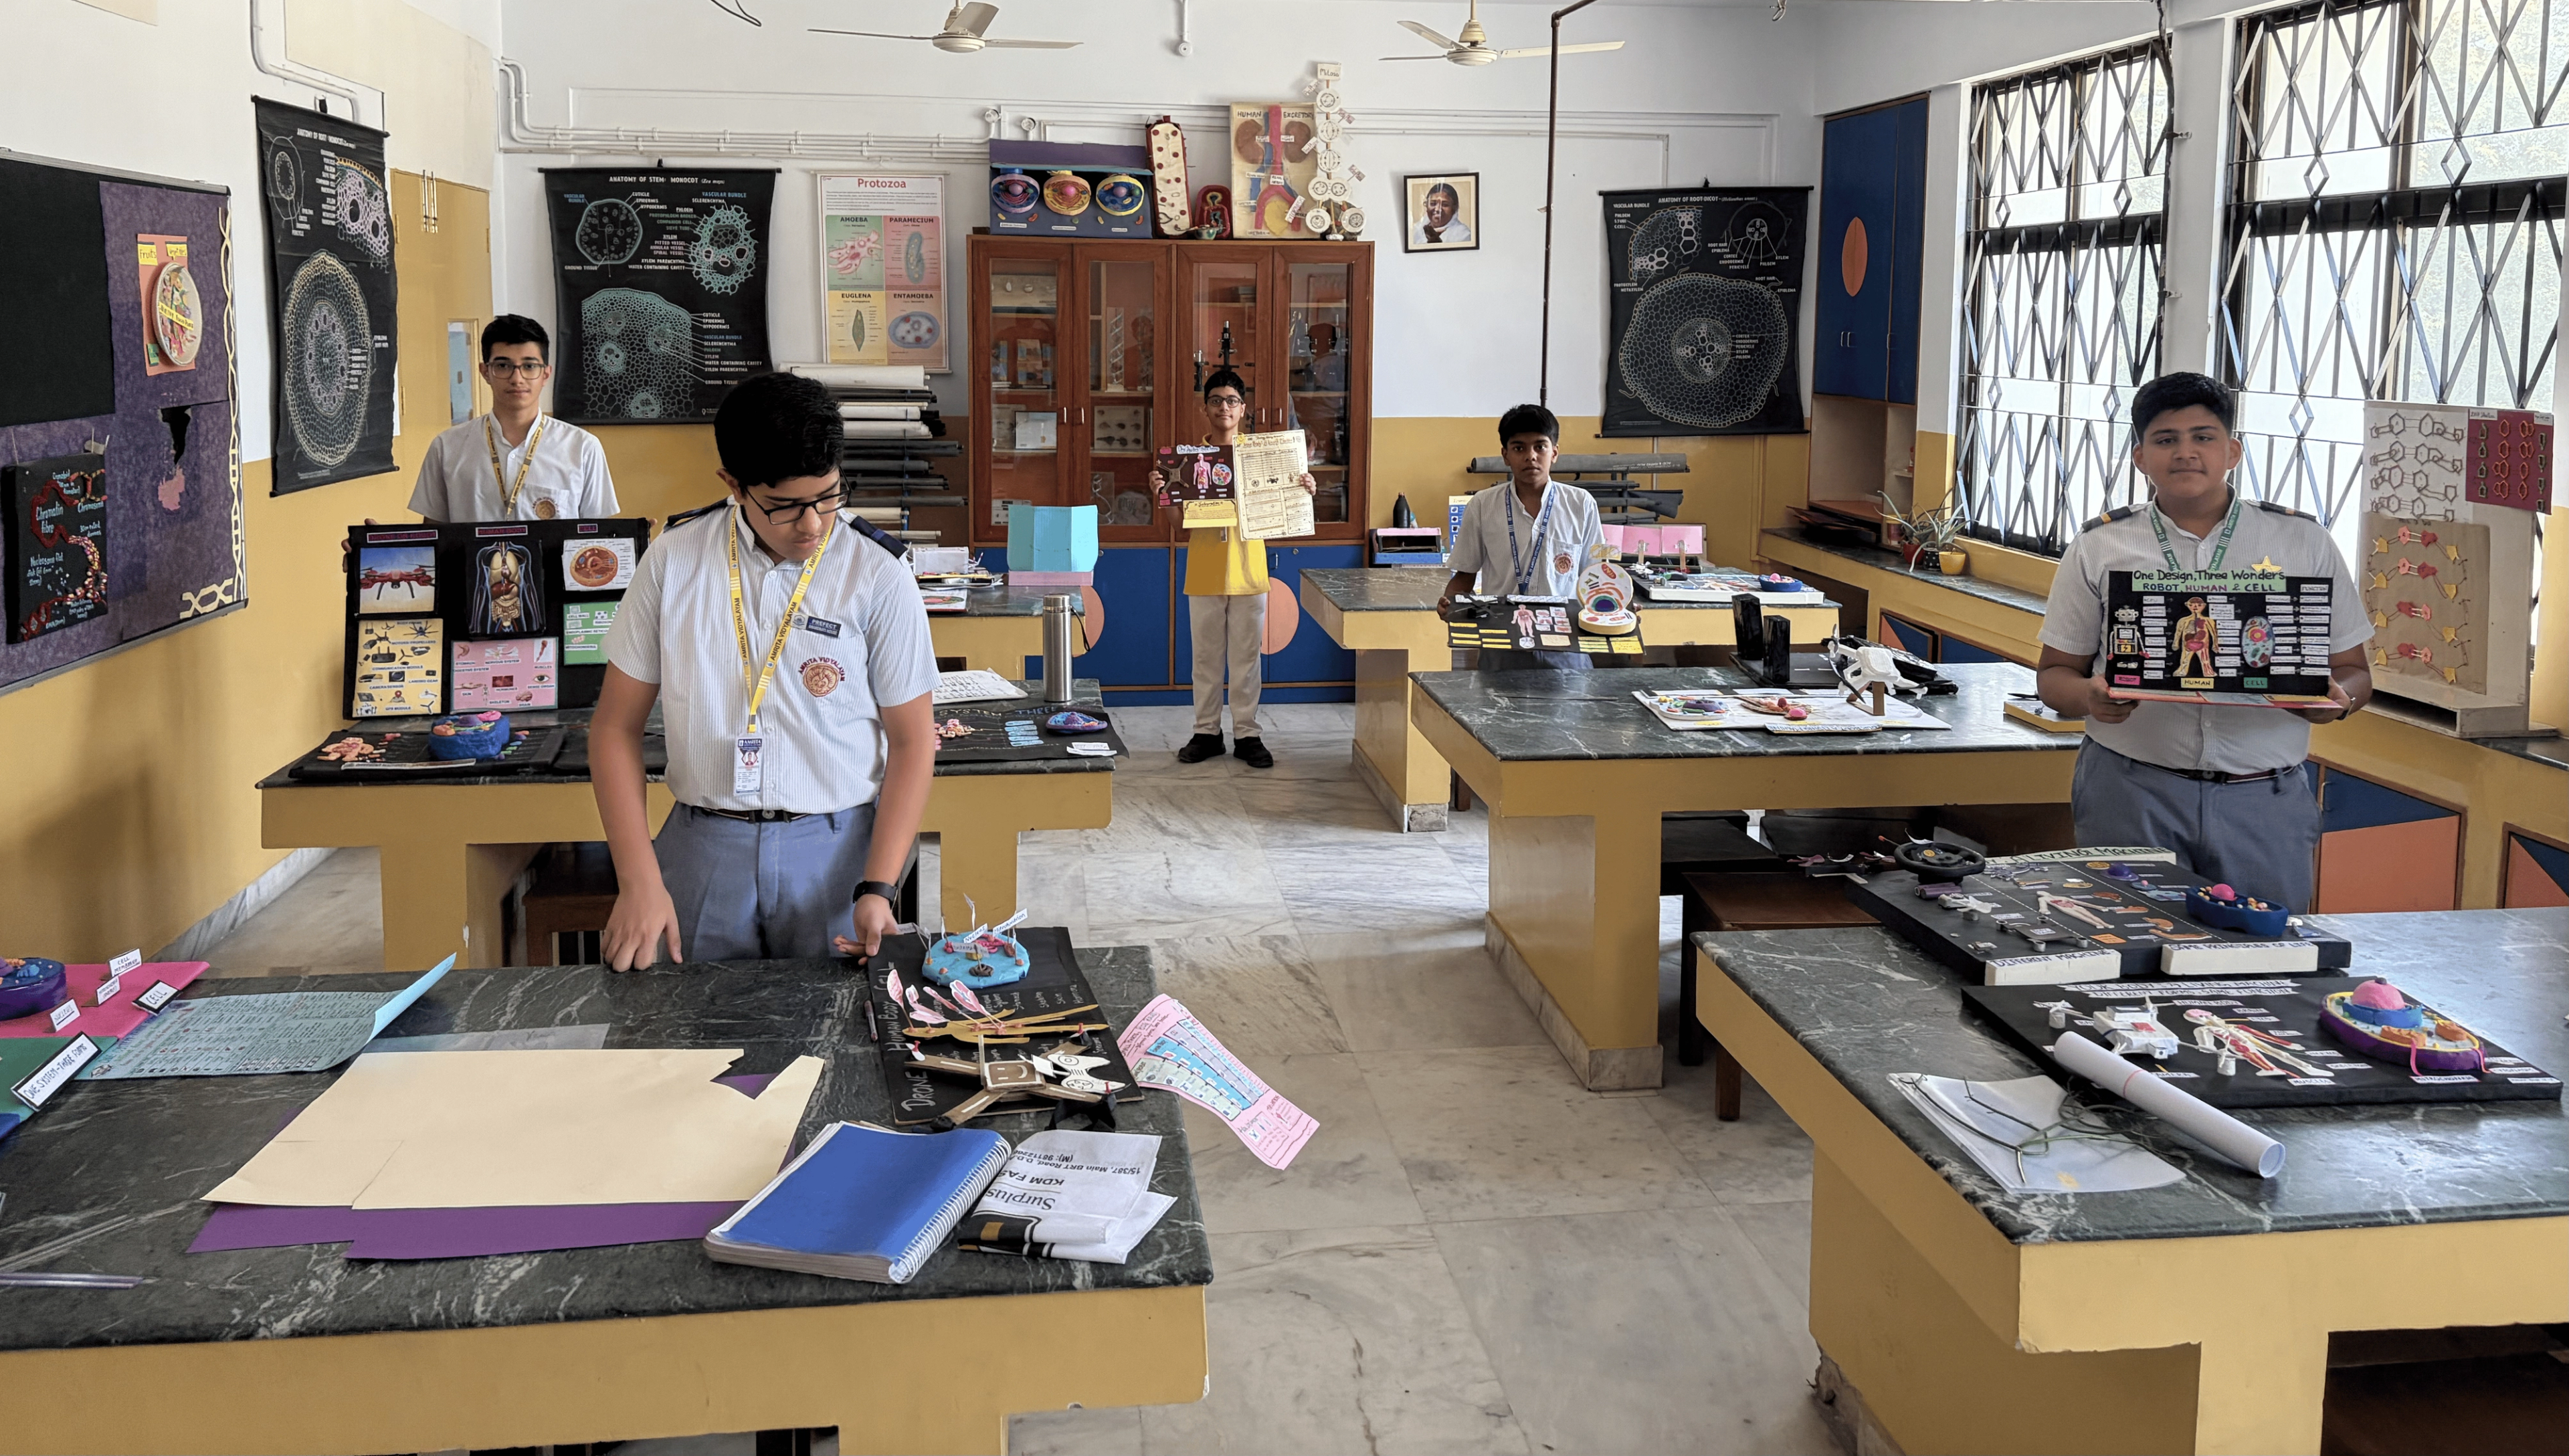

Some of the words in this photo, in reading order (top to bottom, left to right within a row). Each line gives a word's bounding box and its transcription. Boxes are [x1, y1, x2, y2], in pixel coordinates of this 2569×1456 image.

[858, 178, 907, 189] Protozoa
[140, 248, 157, 259] Fruits
[809, 547, 822, 568] AMRITA
[2133, 570, 2154, 580] One
[2158, 569, 2196, 583] Design,
[2194, 570, 2228, 580] Three
[2231, 570, 2286, 580] Wonders
[2245, 583, 2276, 591] CELL
[735, 597, 745, 636] VIDYALAYAM
[779, 601, 797, 636] VIDYALAYAM
[812, 619, 838, 629] PREFECT
[770, 636, 783, 661] AMRITA
[798, 657, 818, 675] AMRITA
[939, 708, 1002, 718] SYSTEM
[1016, 706, 1058, 716] THREE
[2030, 848, 2093, 861] LIVING
[2095, 847, 2172, 857] MACHINE
[117, 956, 130, 965] CELL
[1992, 954, 2052, 967] DIFFERENT
[146, 991, 167, 1005] CELL
[878, 1001, 898, 1020] BODY
[887, 1020, 907, 1052] HUMAN
[23, 1084, 40, 1099] ONE
[901, 1070, 935, 1112] DRONE
[1037, 1160, 1062, 1169] Road,
[1055, 1154, 1074, 1162] (M):
[1086, 1164, 1109, 1173] Main
[1112, 1166, 1141, 1175] 15/387,
[1030, 1176, 1065, 1186] KDM
[987, 1188, 1056, 1211] Surplus
